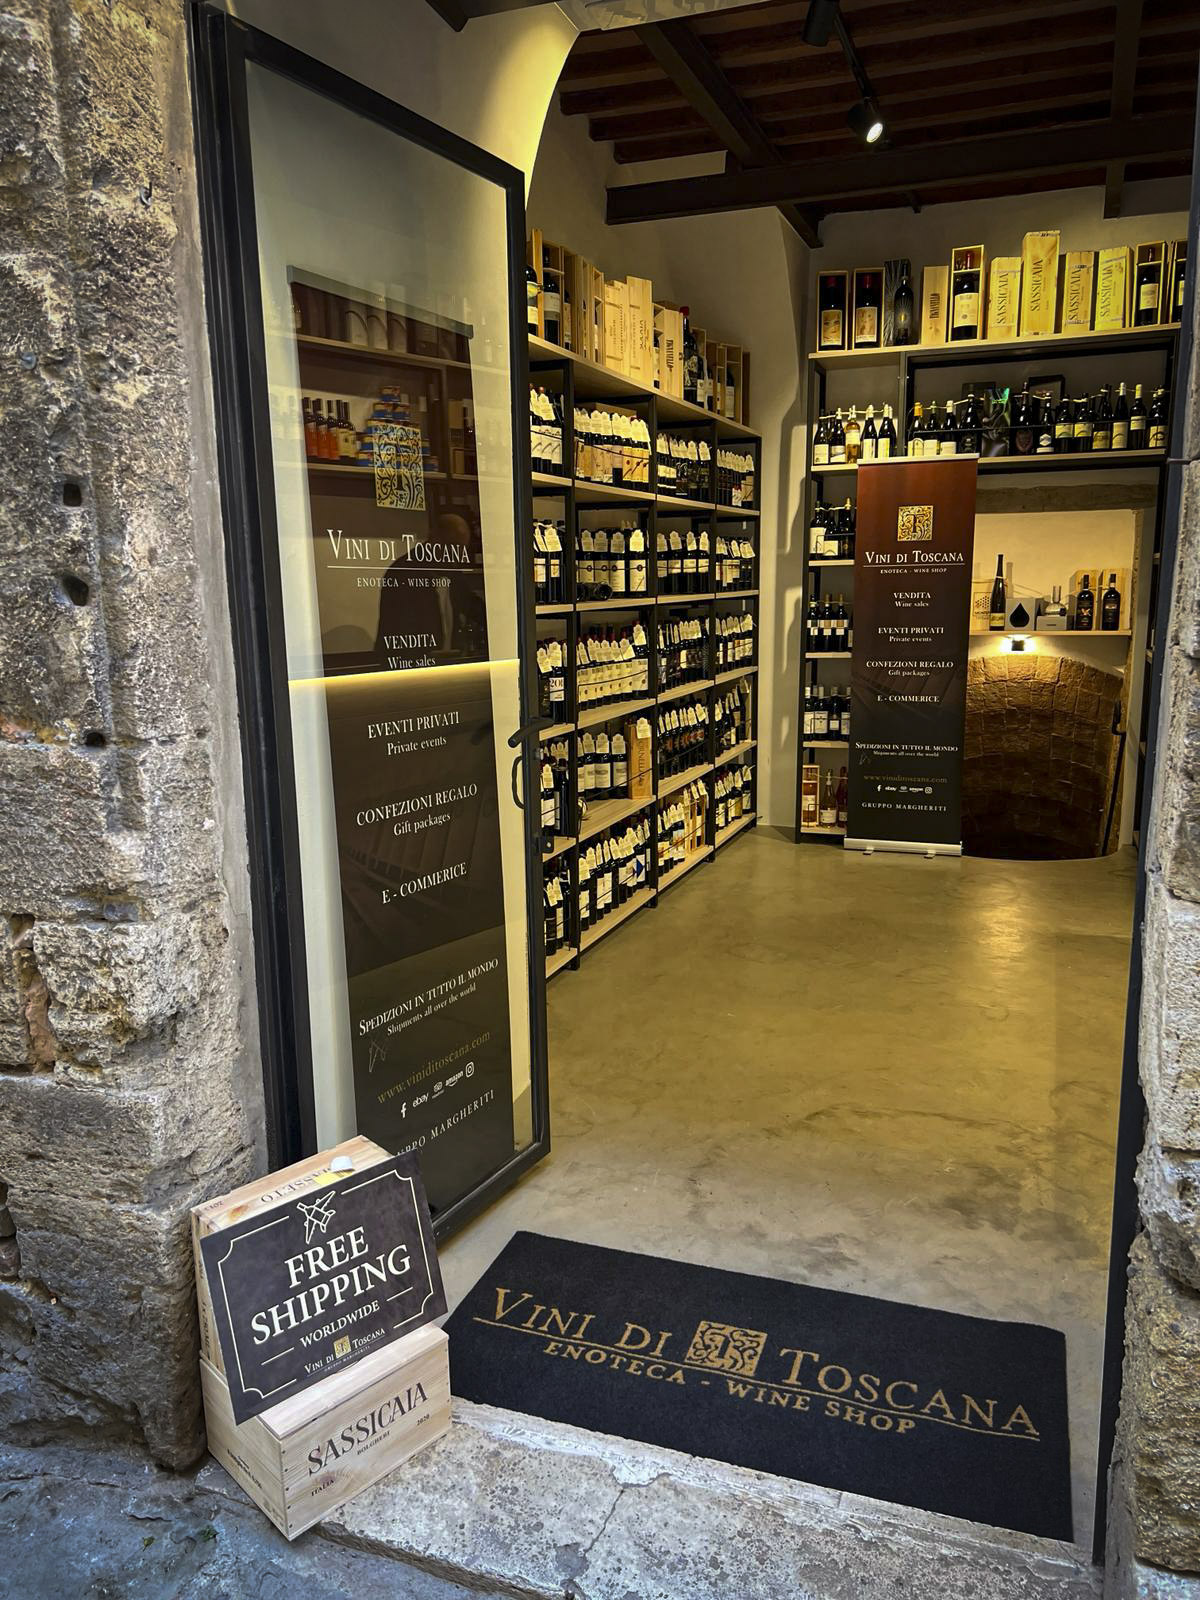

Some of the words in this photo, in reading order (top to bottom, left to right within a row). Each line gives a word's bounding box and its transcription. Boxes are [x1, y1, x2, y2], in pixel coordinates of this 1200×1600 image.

[1030, 258, 1043, 312] SASSICAIA
[357, 577, 399, 588] ENOTECA
[407, 577, 430, 588] WINE
[431, 577, 452, 588] SHOP
[893, 591, 931, 599] VENDITA
[383, 633, 437, 650] VENDITA
[878, 626, 909, 634] EVENTI
[910, 626, 945, 634] PRIVATI
[889, 635, 911, 643] Private
[387, 655, 413, 670] Wine
[415, 655, 436, 668] sales
[866, 660, 918, 669] CONFEZIONI
[919, 660, 954, 669] REGALO
[888, 695, 940, 703] COMMERICE
[367, 718, 414, 739] EVENTI
[416, 711, 460, 731] PRIVATI
[387, 741, 419, 756] Private
[421, 735, 447, 750] events
[356, 794, 432, 826] CONFEZIONI
[435, 783, 478, 806] REGALO
[861, 801, 893, 809] GRUPPO
[896, 804, 947, 812] MARGHERITI
[393, 821, 411, 836] Gift
[414, 811, 451, 832] packages
[381, 889, 391, 904] E
[399, 862, 467, 897] COMMERICE
[414, 994, 425, 1008] IN
[426, 978, 456, 1001] TUTTO
[458, 973, 467, 986] IL
[467, 958, 499, 981] MONDO
[387, 1012, 423, 1036] Shipments
[423, 1005, 433, 1018] all
[433, 999, 447, 1012] over
[448, 992, 459, 1004] the
[459, 982, 477, 998] world
[377, 1031, 491, 1104] www.viniditoscana.com
[430, 1088, 495, 1141] MARGHERITI
[283, 1226, 369, 1288] FREE
[251, 1244, 412, 1345] SHIPPING
[300, 1299, 380, 1348] WORLDWIDE
[543, 1340, 687, 1386] ENOTECA
[724, 1379, 812, 1413] WINE
[825, 1403, 917, 1434] SHOP
[307, 1382, 428, 1477] SASSICAIA
[311, 1479, 335, 1497] ITALIA
